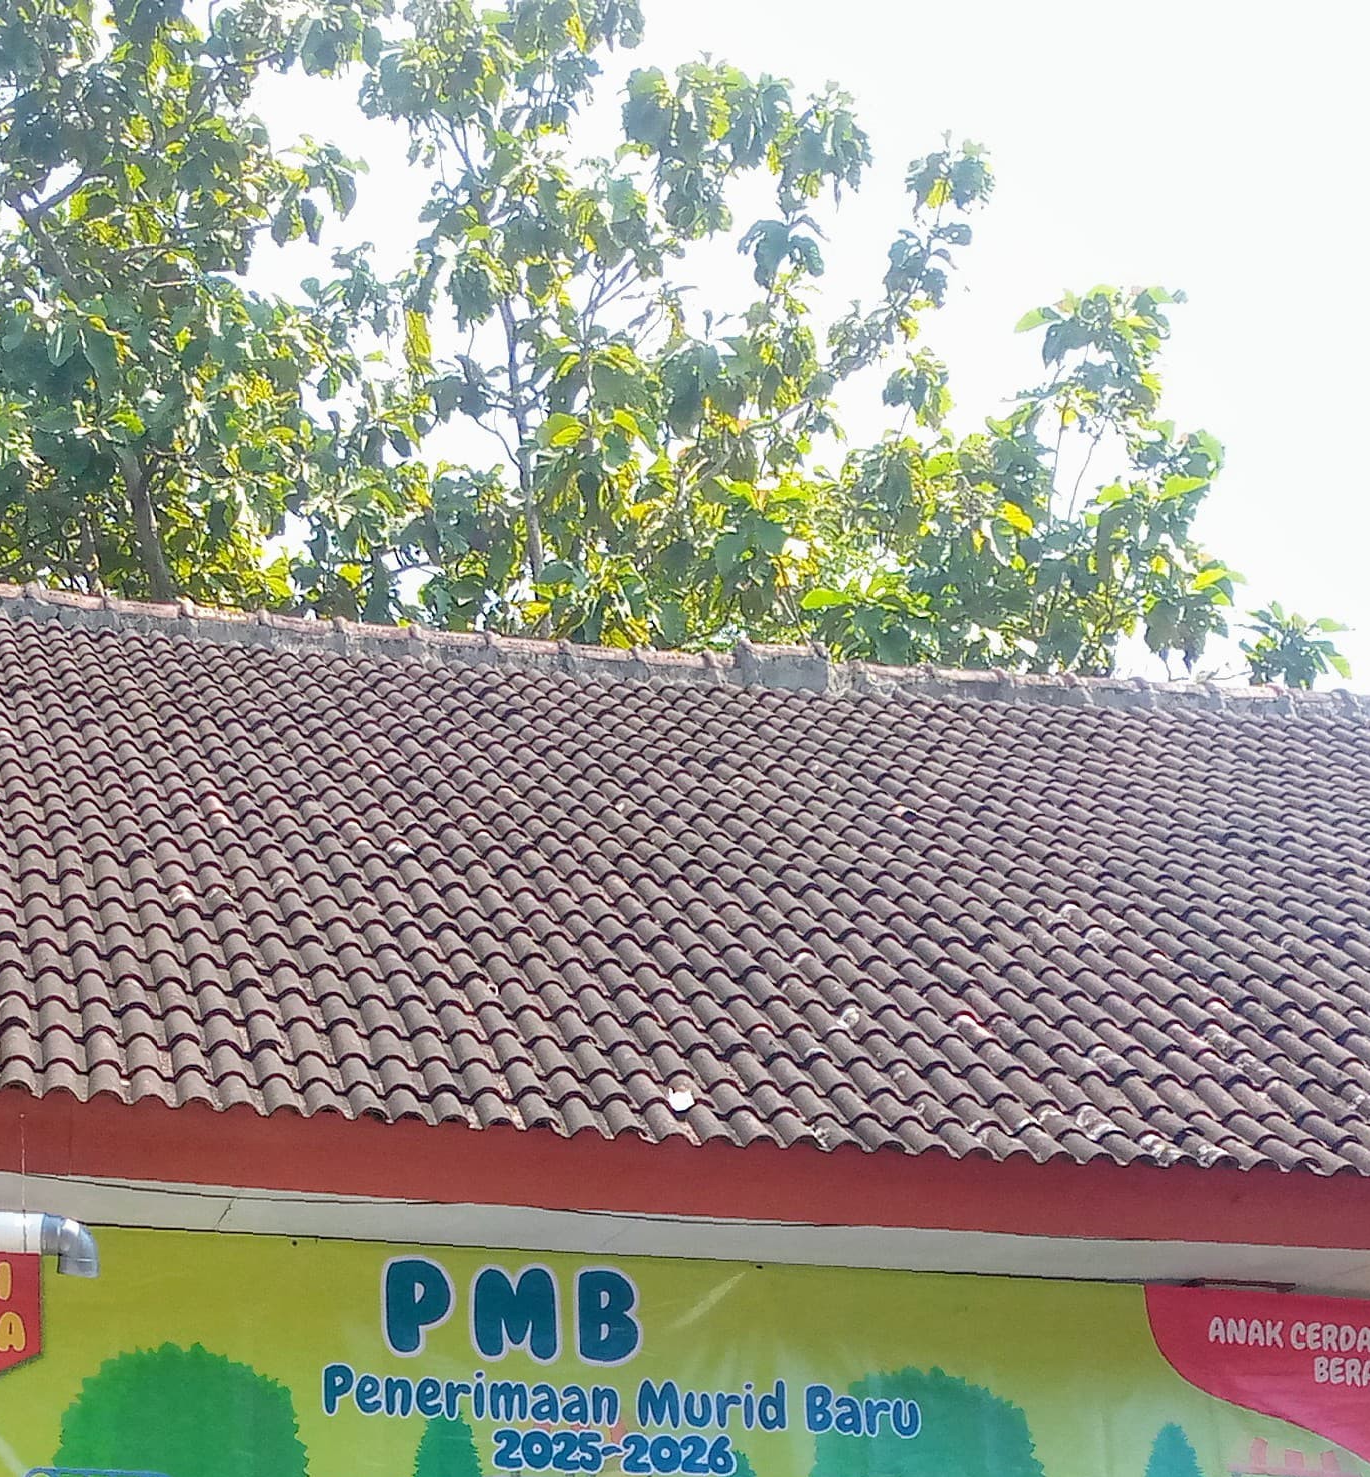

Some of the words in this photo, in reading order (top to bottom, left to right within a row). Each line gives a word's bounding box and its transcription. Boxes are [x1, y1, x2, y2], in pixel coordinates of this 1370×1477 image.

[382, 1256, 643, 1365] PMB
[1208, 1316, 1283, 1348] ANAK
[321, 1364, 620, 1427] Penerimaan
[637, 1378, 788, 1432] Murid
[805, 1383, 922, 1438] Baru
[493, 1428, 737, 1475] 2025-2026
